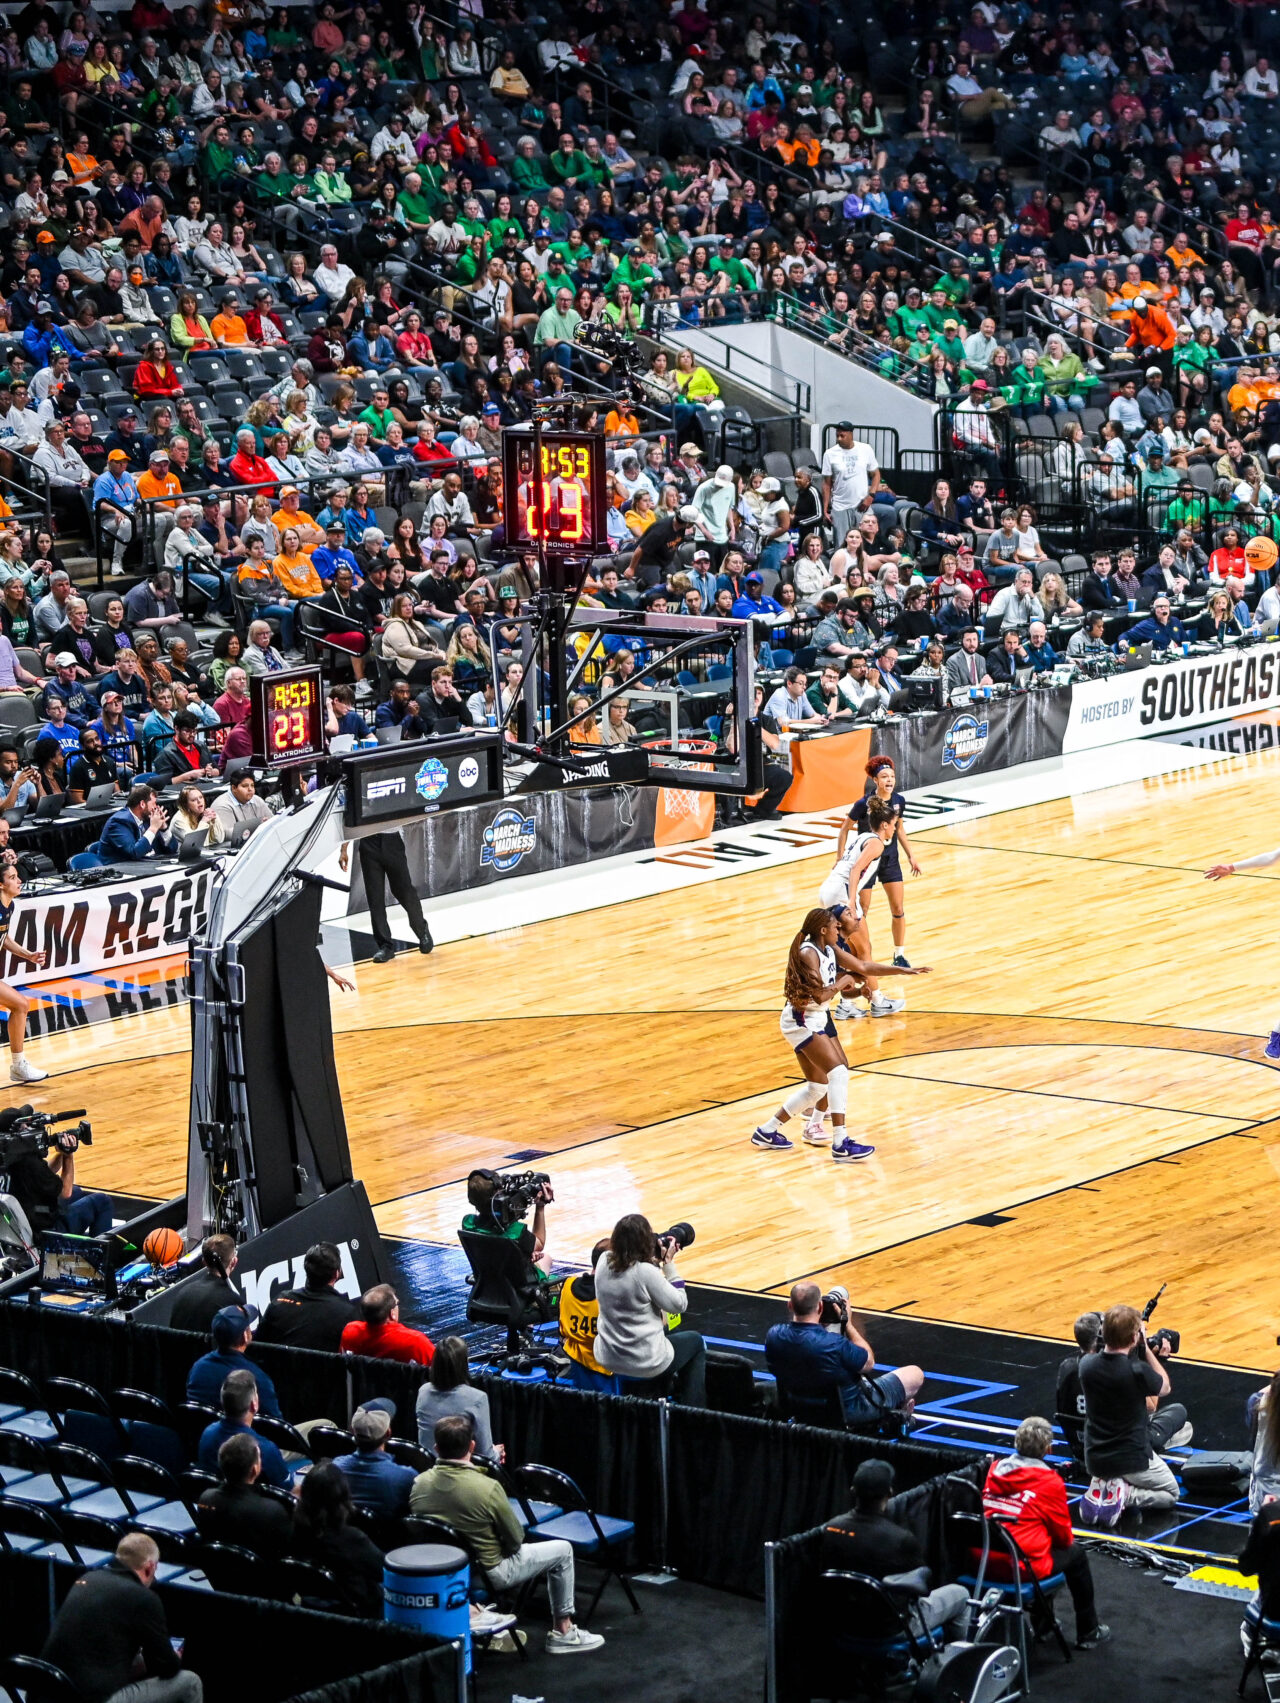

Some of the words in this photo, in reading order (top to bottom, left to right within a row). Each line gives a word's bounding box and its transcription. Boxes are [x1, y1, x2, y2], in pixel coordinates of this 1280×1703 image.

[530, 541, 575, 549] DATRONICS
[275, 681, 311, 710] 9:53
[1081, 702, 1120, 725] HOSTED
[1122, 697, 1135, 716] BY
[274, 711, 306, 750] 23
[952, 727, 977, 744] MARCH
[273, 746, 314, 760] DAKTRONICS
[955, 737, 988, 754] MADNESS
[460, 767, 477, 778] abc
[367, 776, 406, 800] ESPN
[494, 823, 521, 841] MARCH
[495, 833, 535, 853] MADNESS
